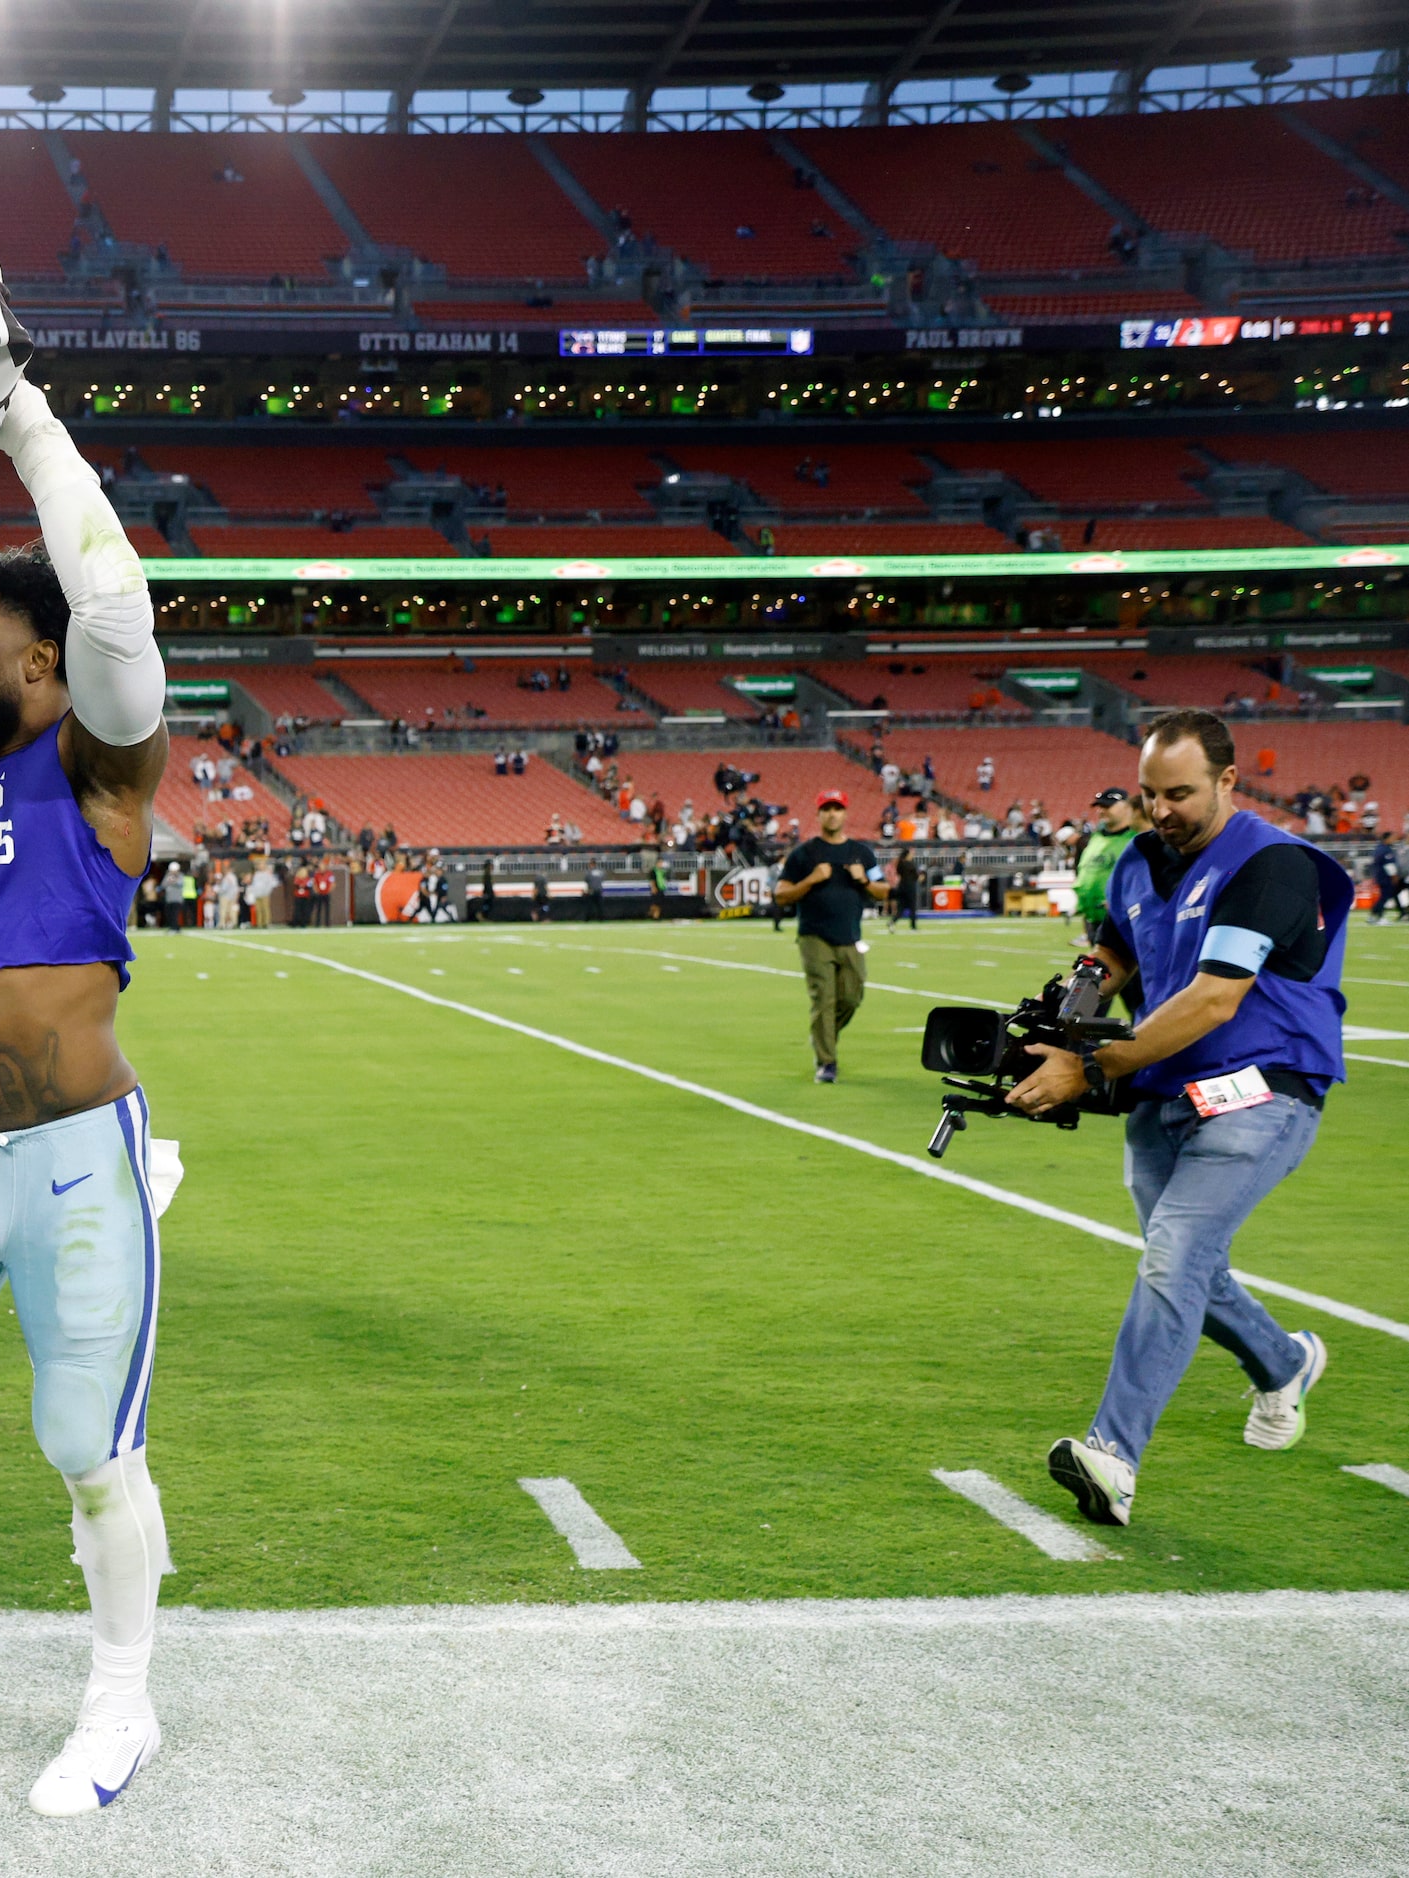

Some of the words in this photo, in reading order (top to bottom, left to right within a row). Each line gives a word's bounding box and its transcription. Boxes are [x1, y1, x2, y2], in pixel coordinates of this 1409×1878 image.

[32, 329, 88, 349] ANTE
[93, 329, 169, 349] LAVELLI
[174, 329, 200, 351] 86
[359, 332, 410, 351] OTTO
[414, 332, 491, 351] GRAHAM
[498, 332, 519, 353] 14
[906, 329, 954, 348] PAUL
[957, 328, 1023, 347] BROWN
